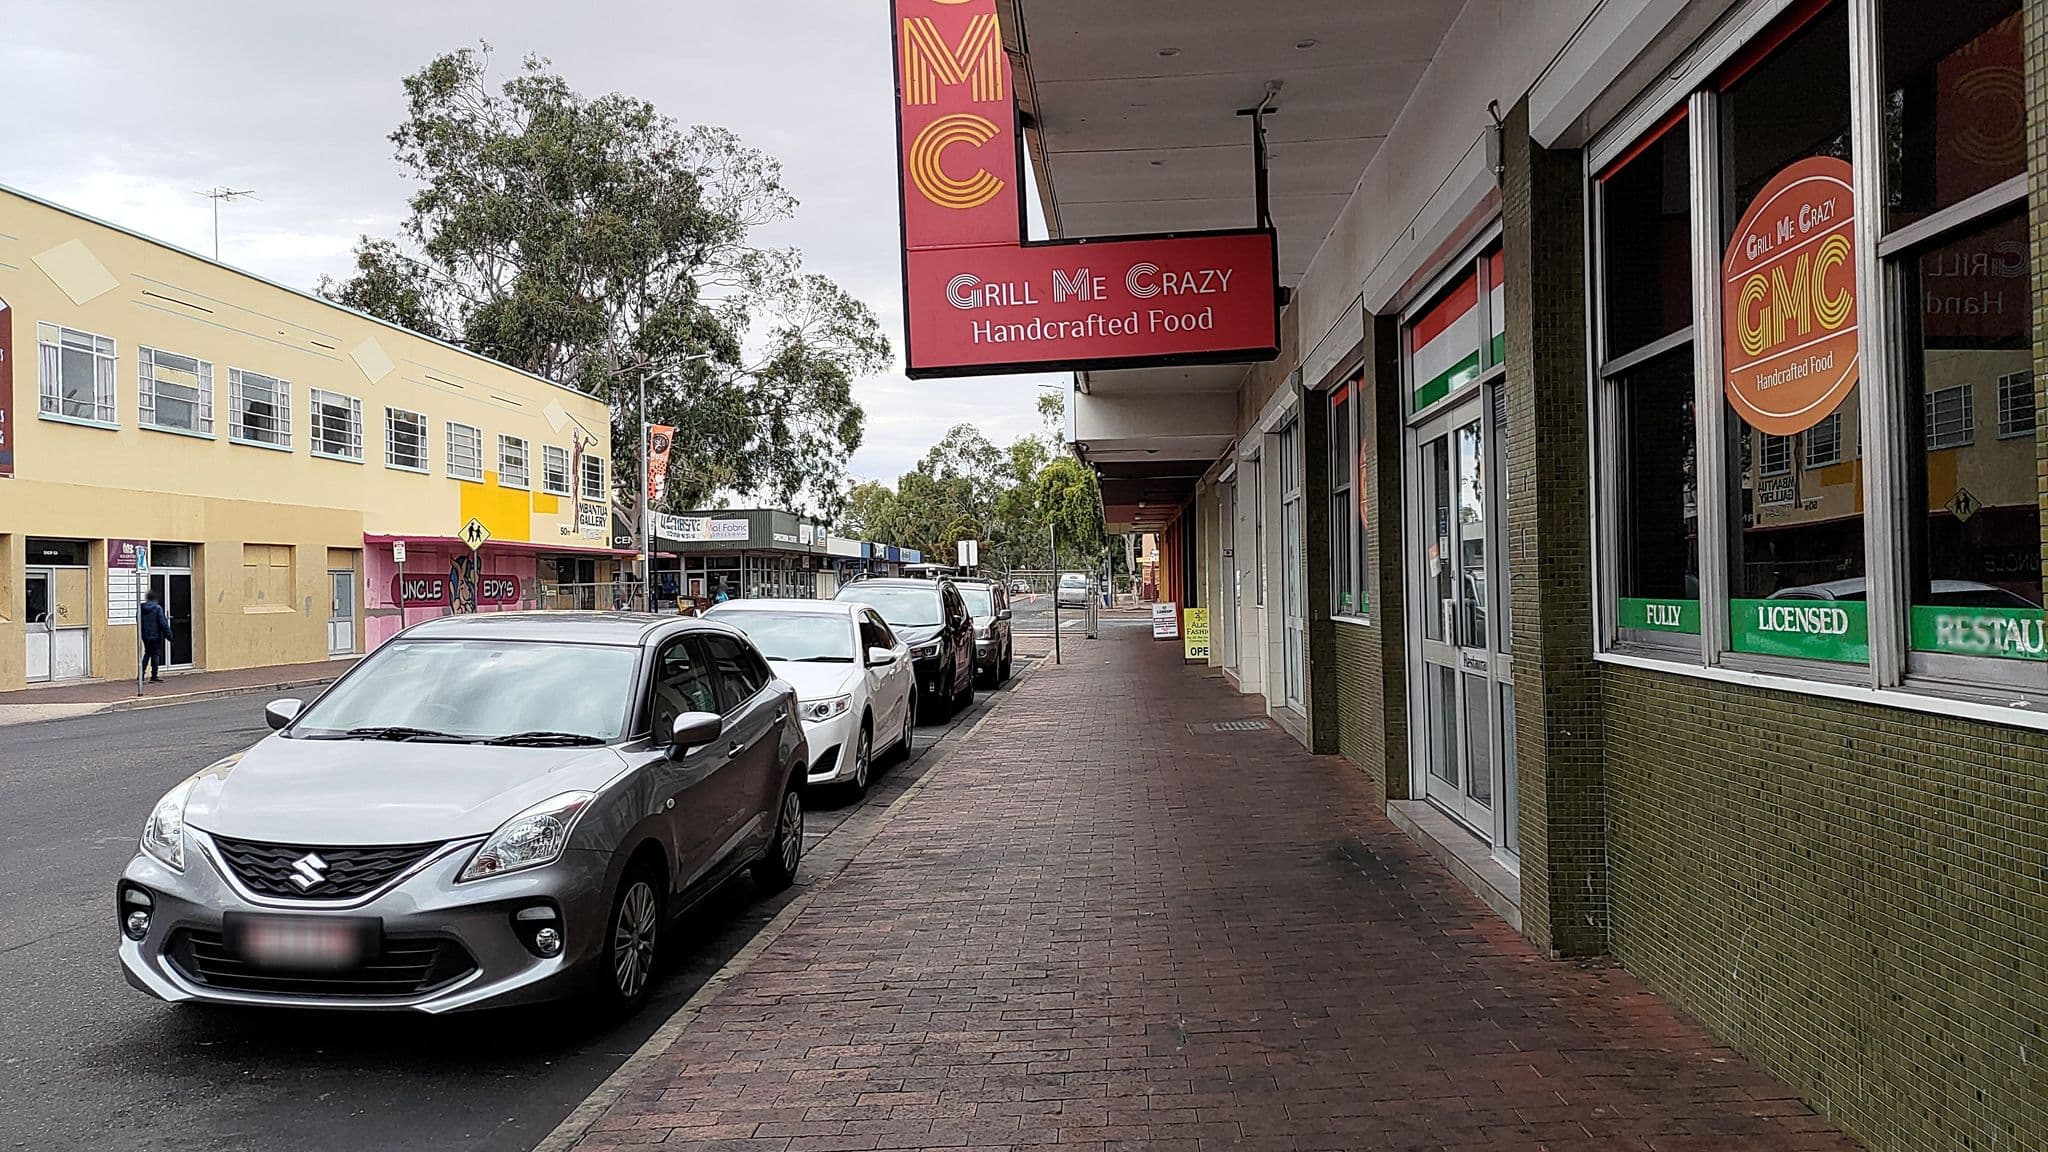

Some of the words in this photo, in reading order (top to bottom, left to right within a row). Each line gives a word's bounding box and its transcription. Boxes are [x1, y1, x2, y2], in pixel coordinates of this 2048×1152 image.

[902, 0, 1005, 209] MC
[1746, 235, 1774, 261] GRILL
[1776, 216, 1795, 246] ME
[1799, 198, 1836, 233] CRAZY
[946, 273, 1039, 310] GRILL
[1052, 267, 1108, 303] ME
[1125, 262, 1233, 299] CRAZY
[1738, 234, 1853, 357] GMC
[971, 311, 1139, 344] Handcrafted
[1148, 306, 1214, 333] Food
[1756, 362, 1808, 392] Handcrafted
[1811, 351, 1834, 374] Food
[579, 502, 608, 517] MBANTUA
[580, 513, 607, 527] GALLERY
[401, 579, 442, 599] UNCLE
[483, 580, 515, 598] EDY'S
[1646, 604, 1682, 626] FULLY
[1758, 606, 1849, 635] LICENSED
[1936, 615, 2046, 653] RESTAU
[1191, 647, 1208, 656] OPE
